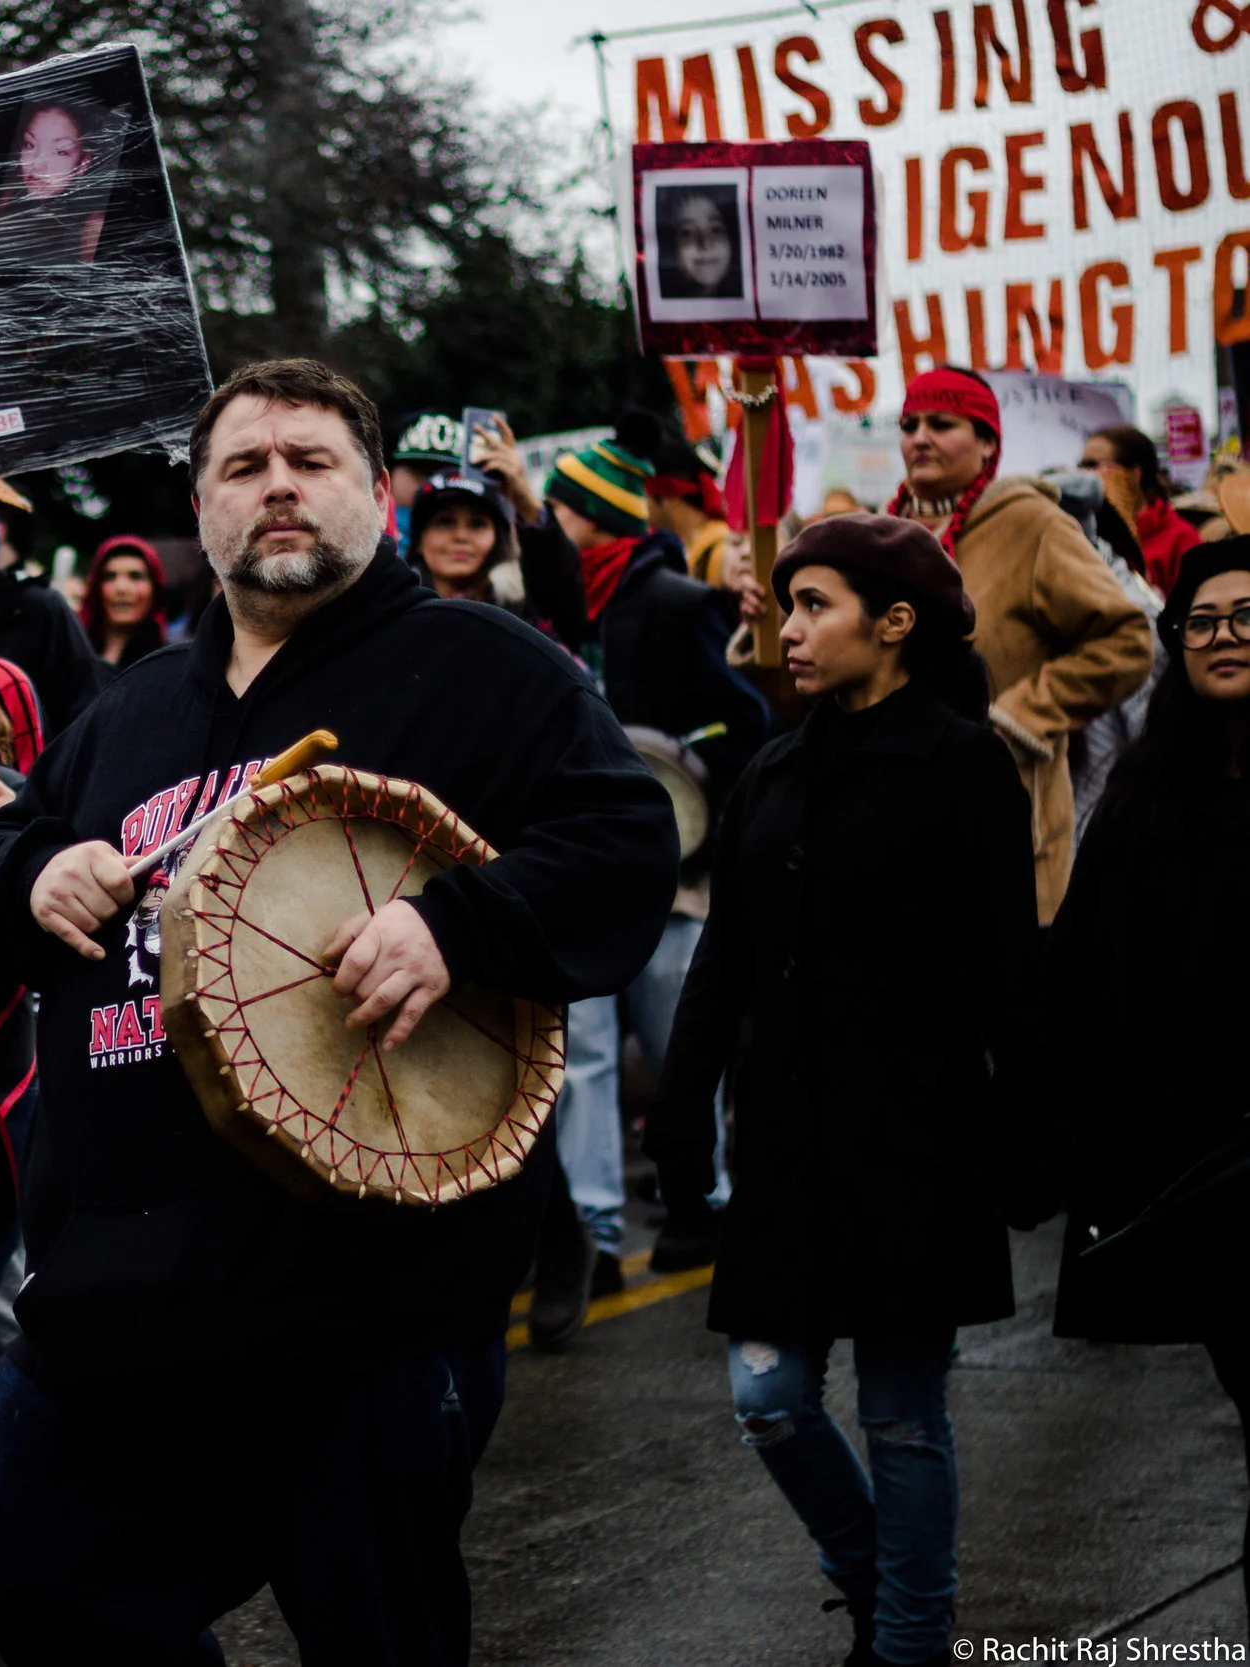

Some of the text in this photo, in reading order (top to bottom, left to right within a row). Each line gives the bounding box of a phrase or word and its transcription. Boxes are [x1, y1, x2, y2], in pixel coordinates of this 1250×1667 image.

[636, 0, 1108, 143] MISSING
[766, 186, 828, 201] DOREEN
[766, 215, 823, 230] MILNER
[769, 243, 845, 261] 3/20/1982
[770, 271, 847, 288] 1/14/2005
[89, 994, 167, 1056] NAT
[90, 1044, 162, 1069] WARRIORS
